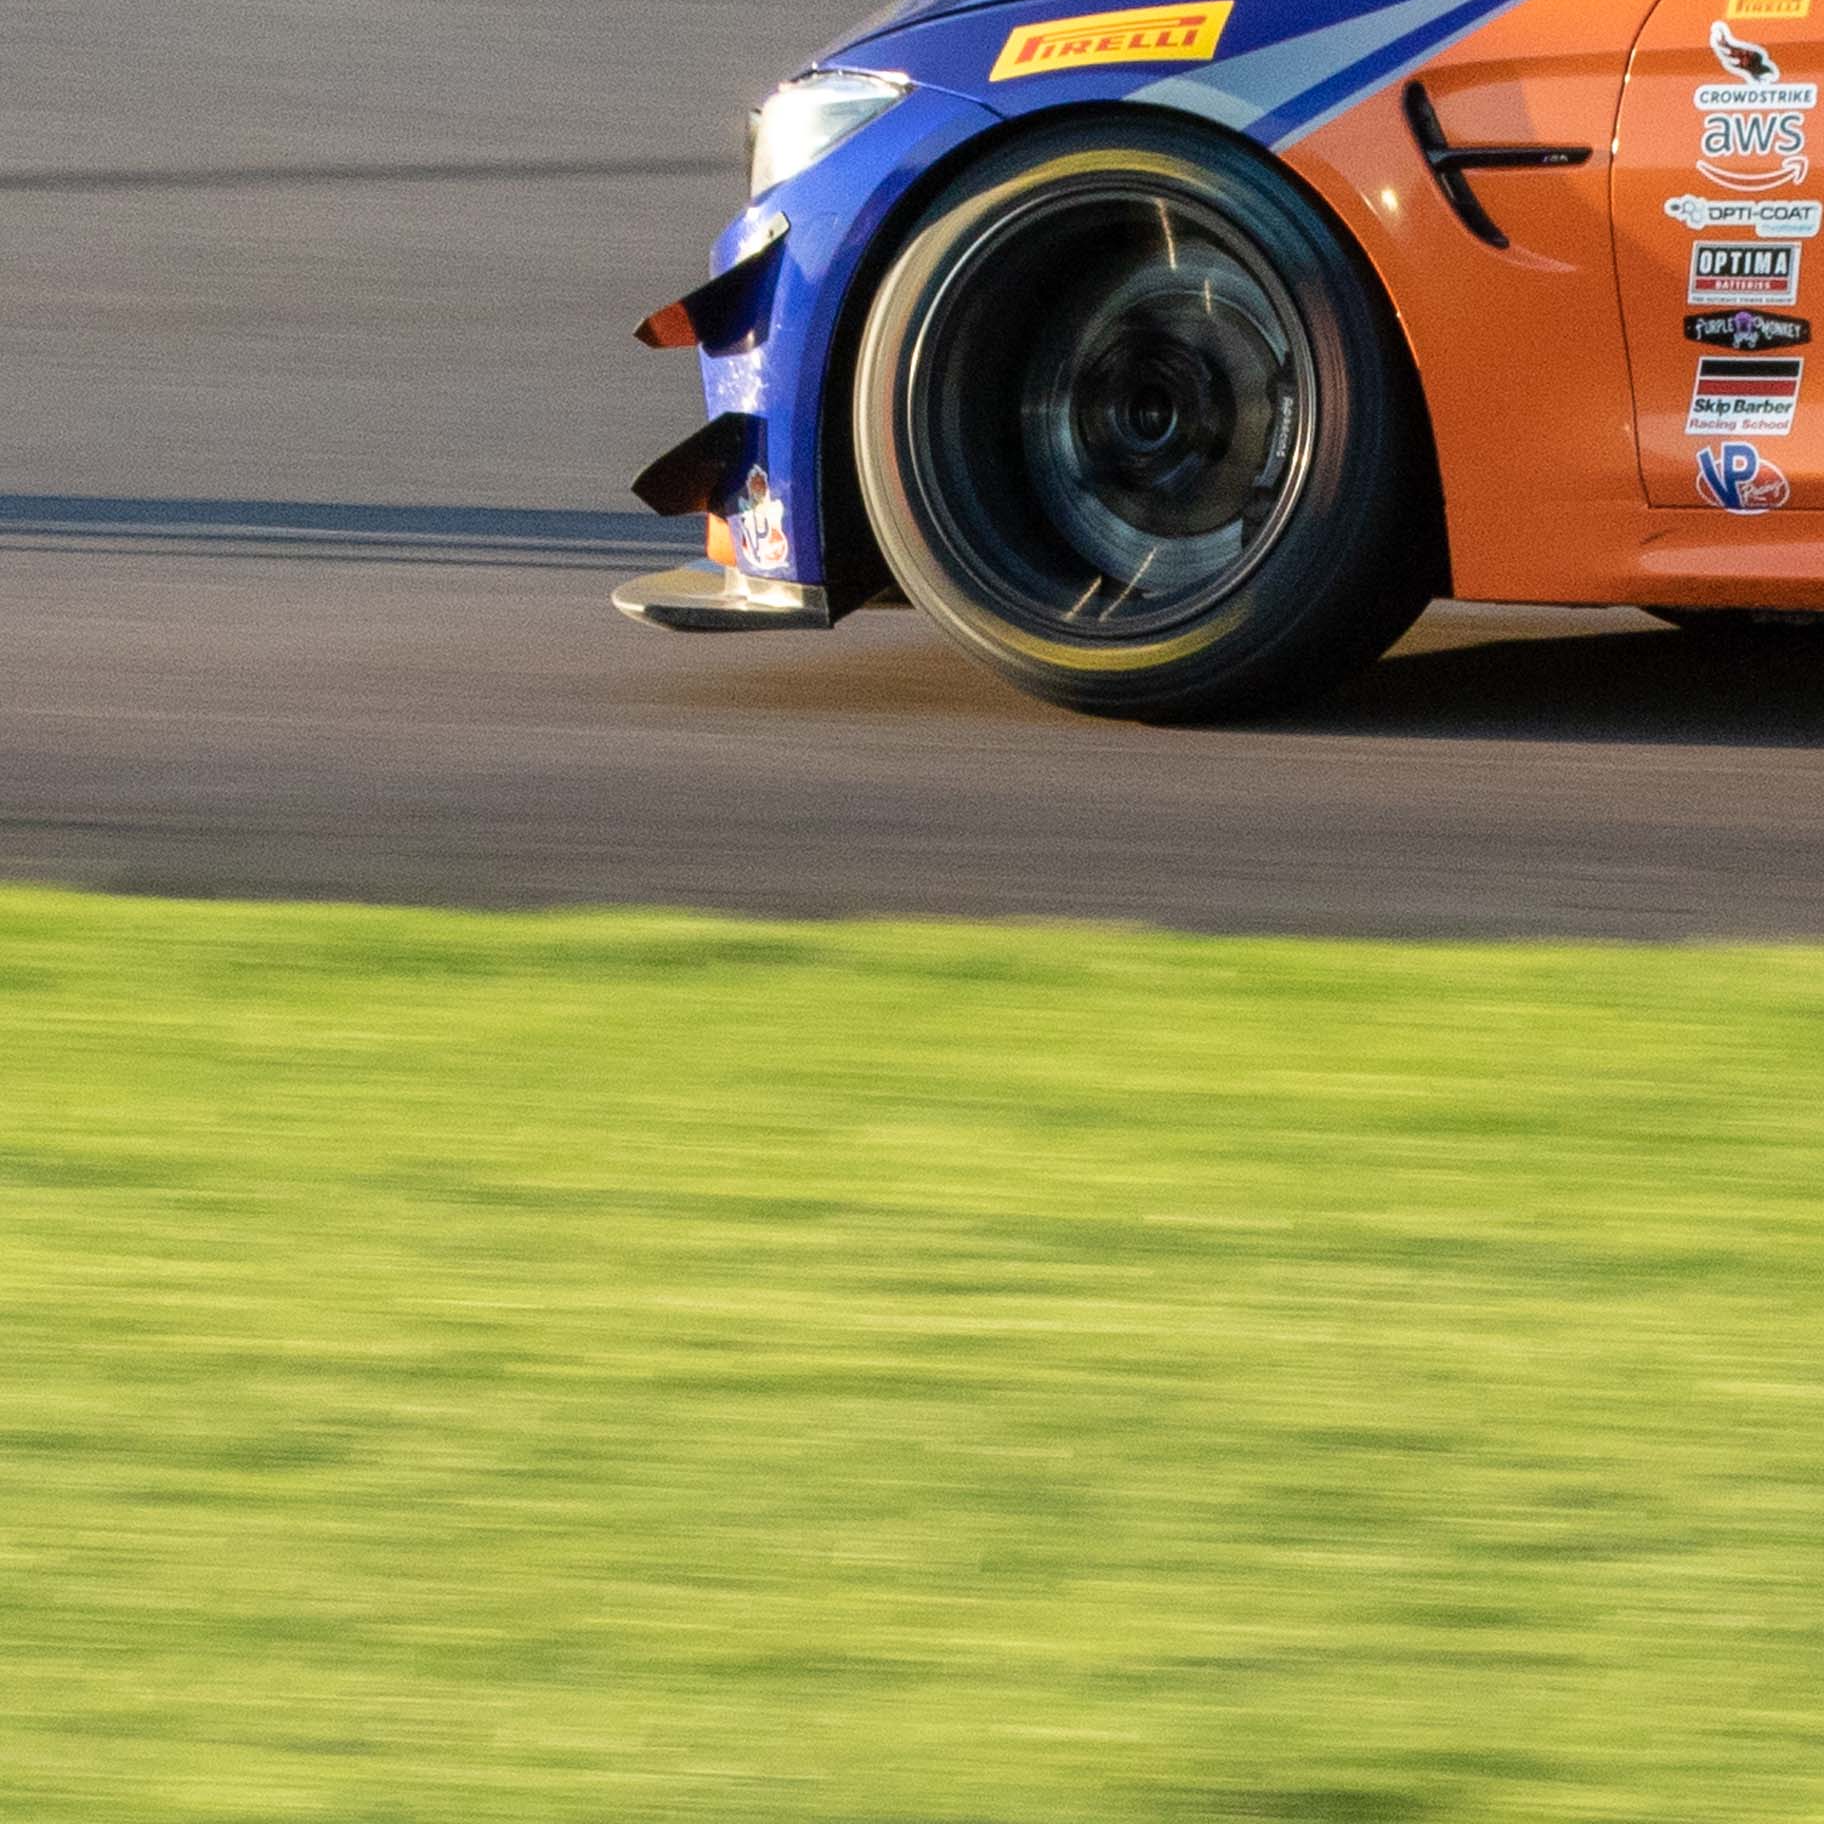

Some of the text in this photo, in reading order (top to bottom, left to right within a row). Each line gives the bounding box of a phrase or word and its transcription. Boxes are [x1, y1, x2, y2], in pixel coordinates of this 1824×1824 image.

[1014, 16, 1207, 65] PIRELLI
[1700, 90, 1812, 104] CROWDSTRIKE
[1705, 115, 1801, 152] aws
[1708, 206, 1813, 221] OPTI-COAT
[1699, 250, 1788, 274] OPTIMA
[1694, 398, 1793, 416] Skip Barber
[1689, 419, 1790, 431] Racing School
[1699, 444, 1758, 510] VP
